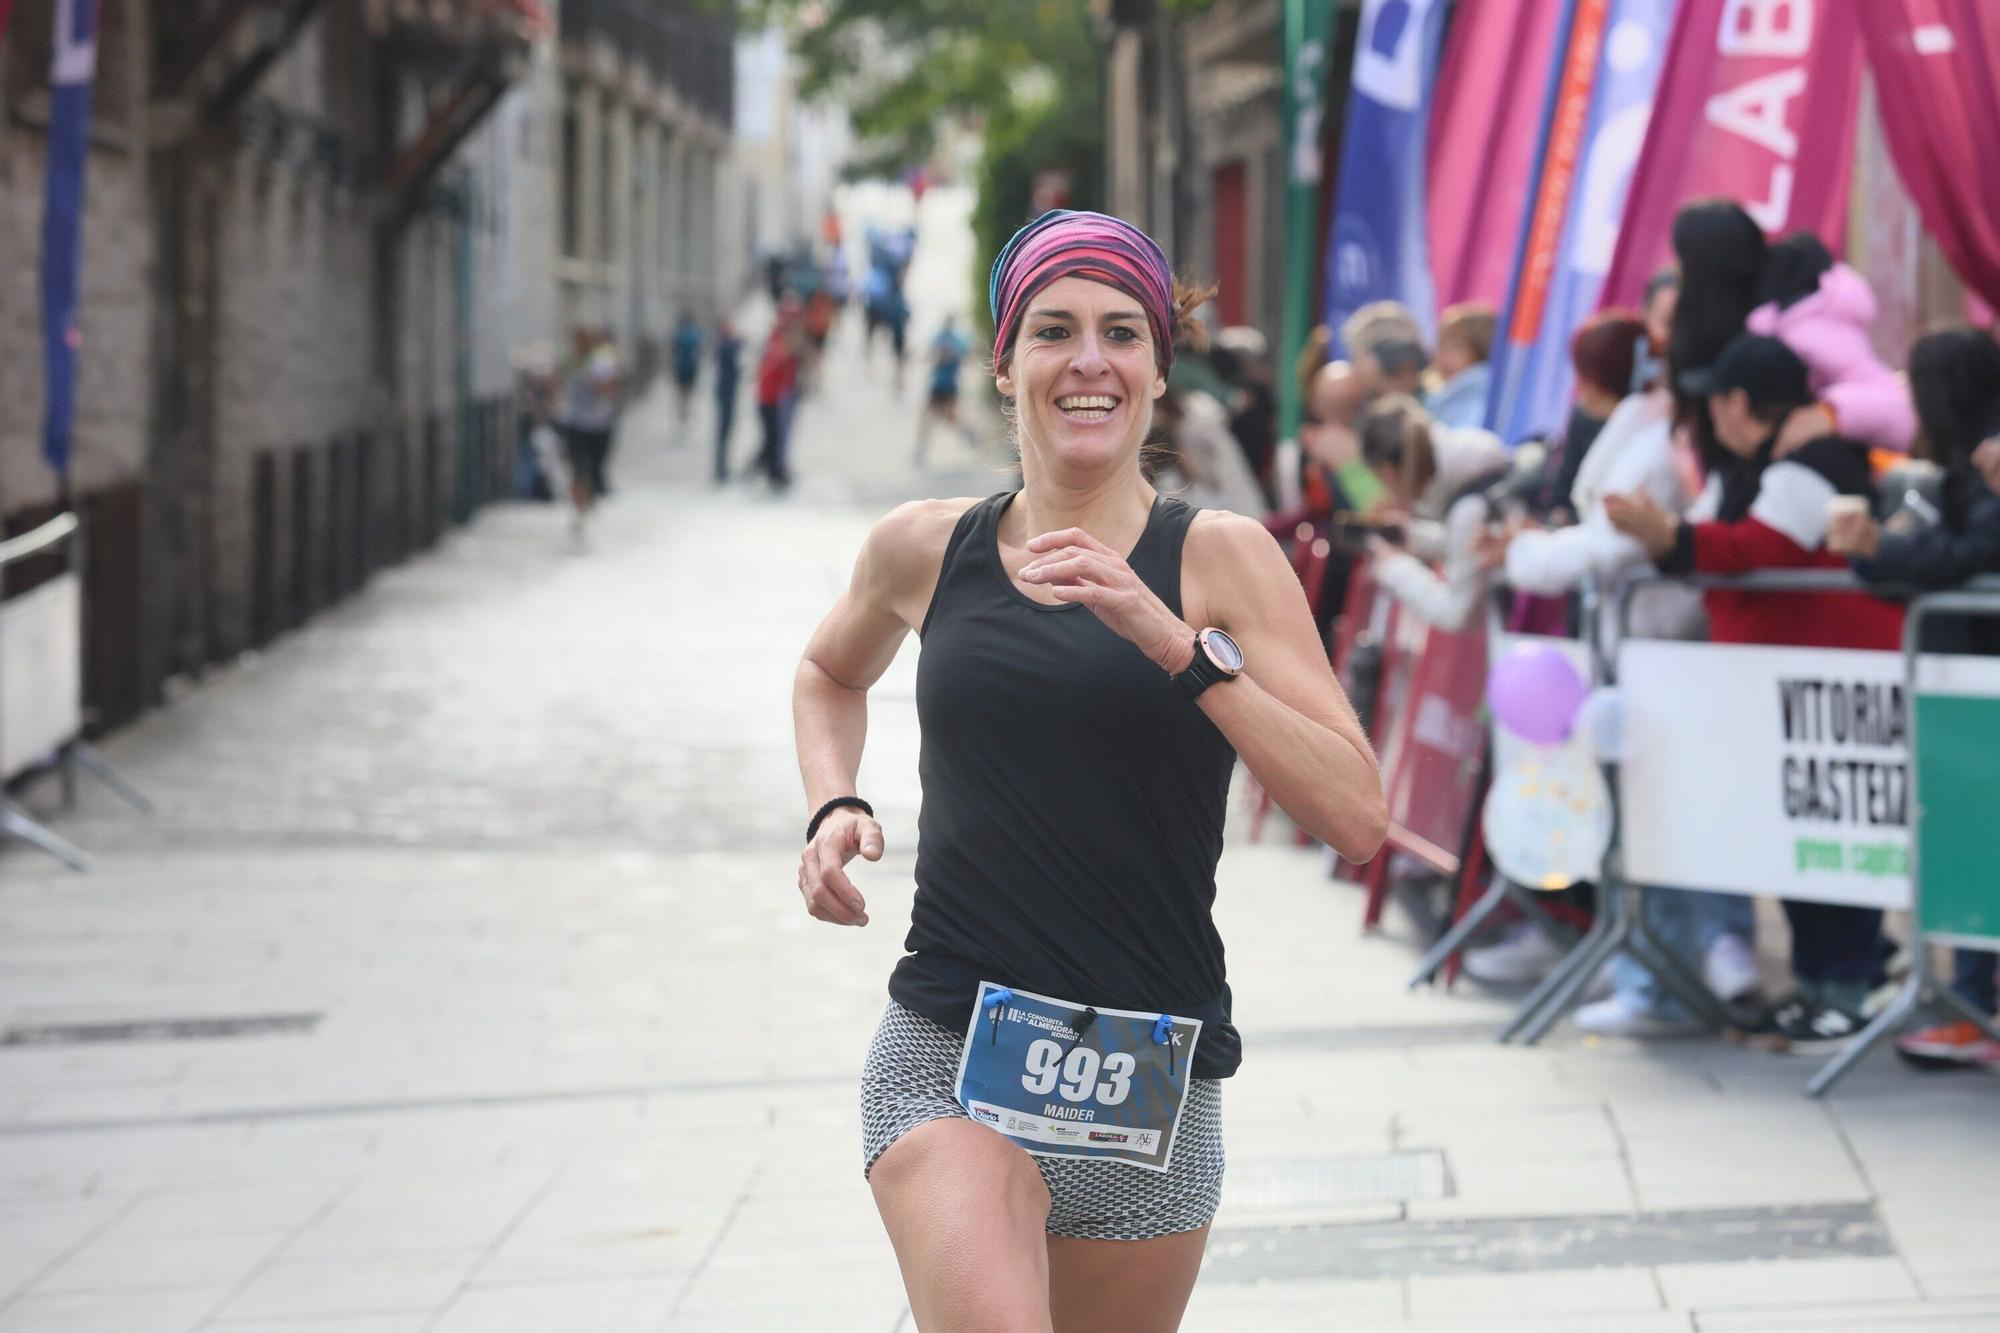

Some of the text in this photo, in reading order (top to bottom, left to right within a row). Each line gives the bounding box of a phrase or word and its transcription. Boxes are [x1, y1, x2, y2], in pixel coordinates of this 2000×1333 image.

[1779, 679, 1906, 746] VITORIA
[1784, 757, 1907, 826] GASTEIZ
[1027, 1018, 1074, 1035] ALMENDRA
[1021, 1038, 1136, 1106] 993
[1043, 1103, 1095, 1121] MAIDER
